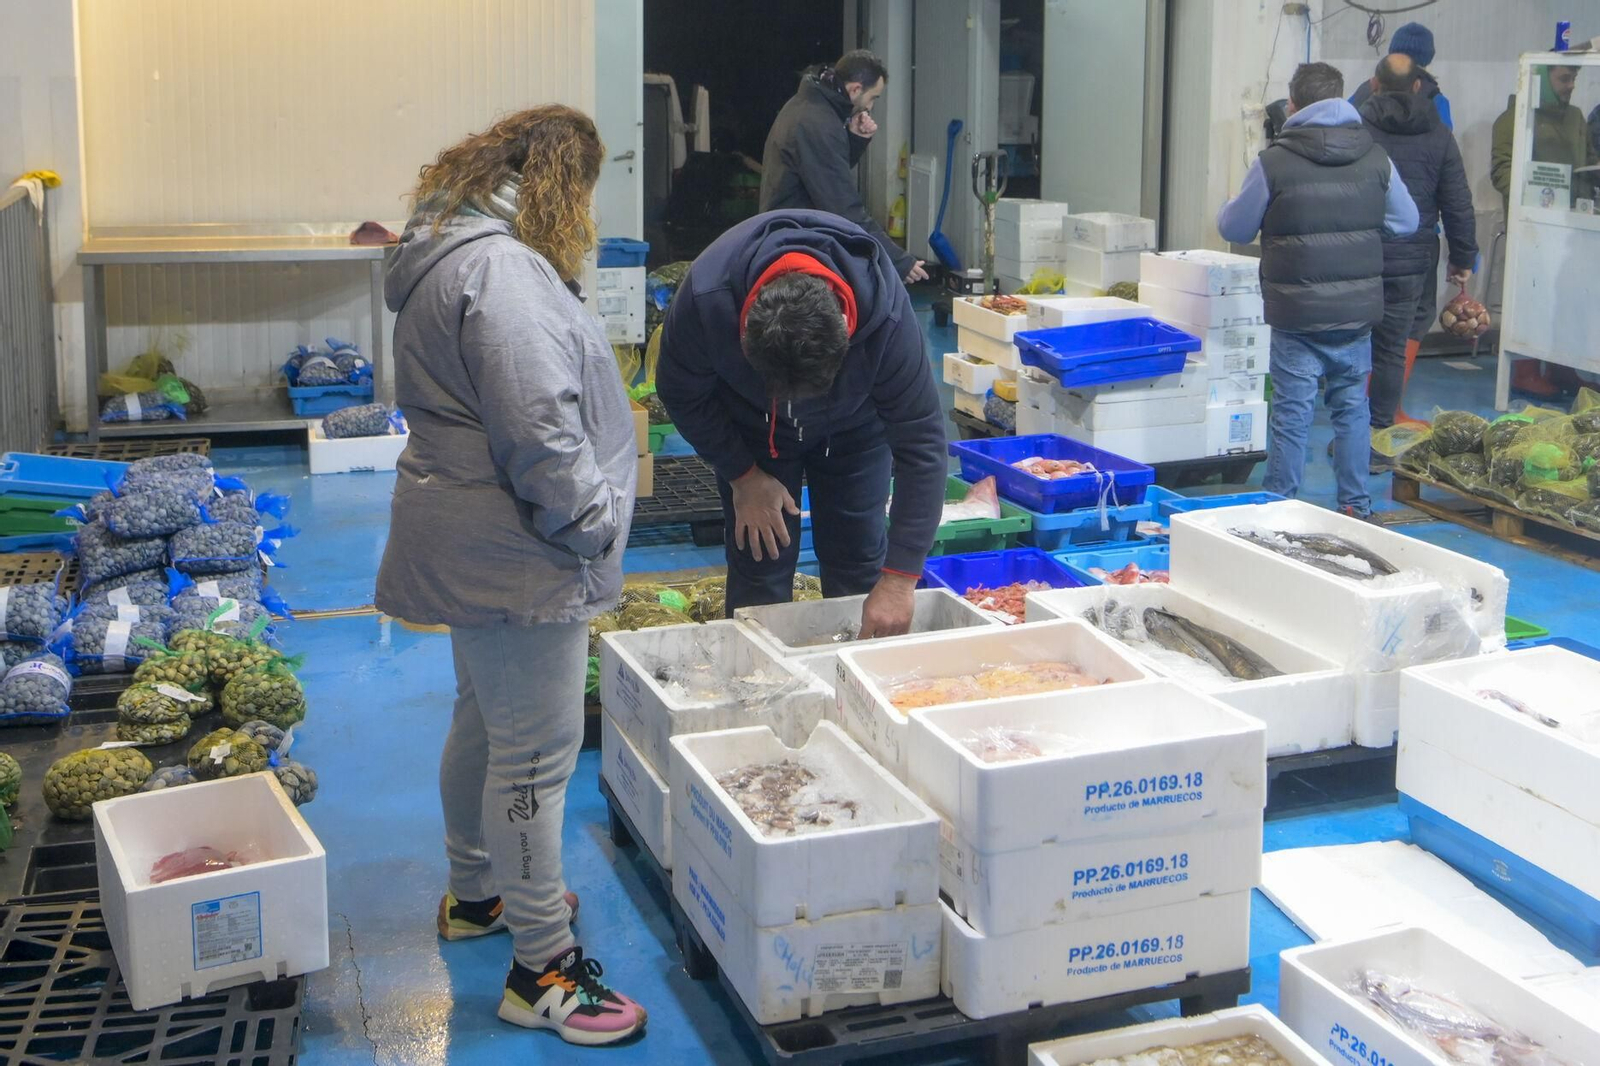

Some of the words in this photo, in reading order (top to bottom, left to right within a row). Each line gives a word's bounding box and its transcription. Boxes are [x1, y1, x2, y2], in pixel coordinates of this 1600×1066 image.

[1085, 772, 1203, 800] PP.26.0169.18
[1084, 802, 1126, 815] Producto
[1128, 800, 1139, 809] de
[1142, 791, 1203, 807] MARRUECOS
[520, 832, 531, 854] your
[521, 855, 532, 880] Bring
[1073, 853, 1189, 885] PP.26.0169.18
[1072, 886, 1113, 899] Producto
[1115, 883, 1126, 892] de
[1129, 872, 1189, 890] MARRUECOS
[1068, 935, 1184, 963] PP.26.0169.18
[1066, 964, 1107, 976] Producto
[1110, 962, 1121, 970] de
[1123, 954, 1183, 969] MARRUECOS
[1331, 1022, 1395, 1066] PP.26.01
